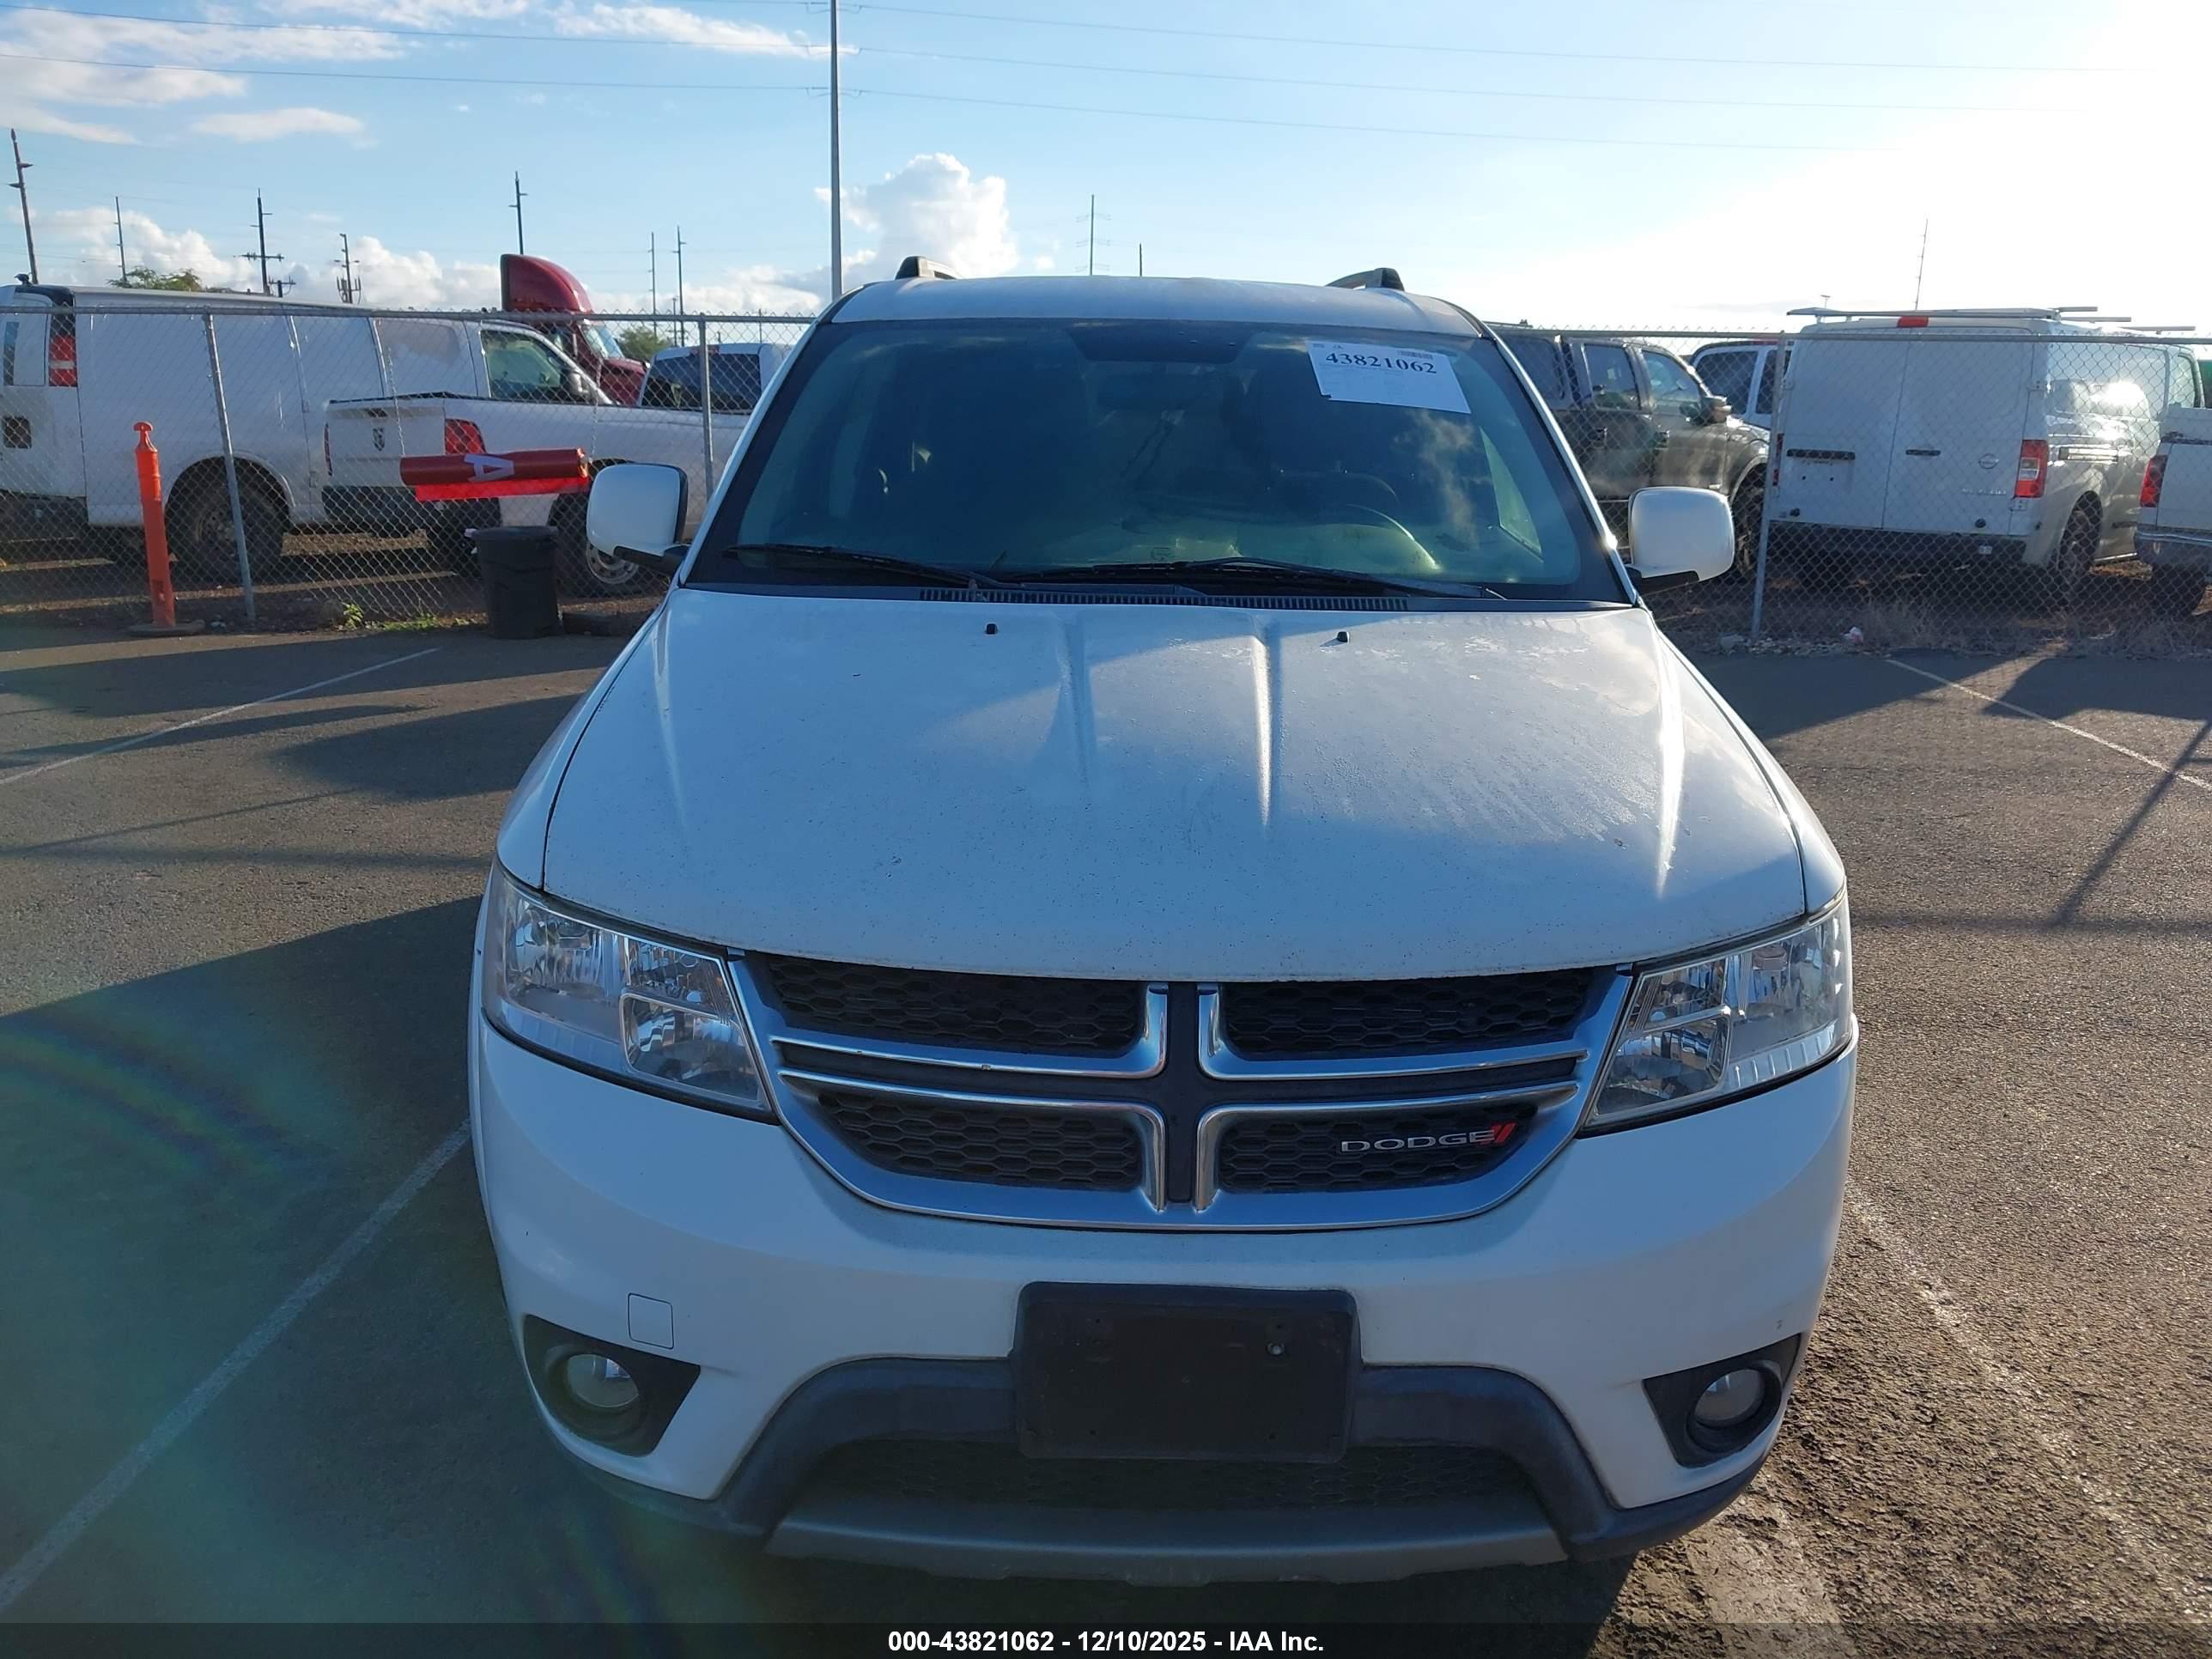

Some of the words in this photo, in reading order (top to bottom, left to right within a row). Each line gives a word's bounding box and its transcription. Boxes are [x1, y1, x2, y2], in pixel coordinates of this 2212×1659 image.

[1326, 352, 1437, 374] 43821062
[464, 453, 515, 482] A
[1340, 1129, 1496, 1152] DODGE
